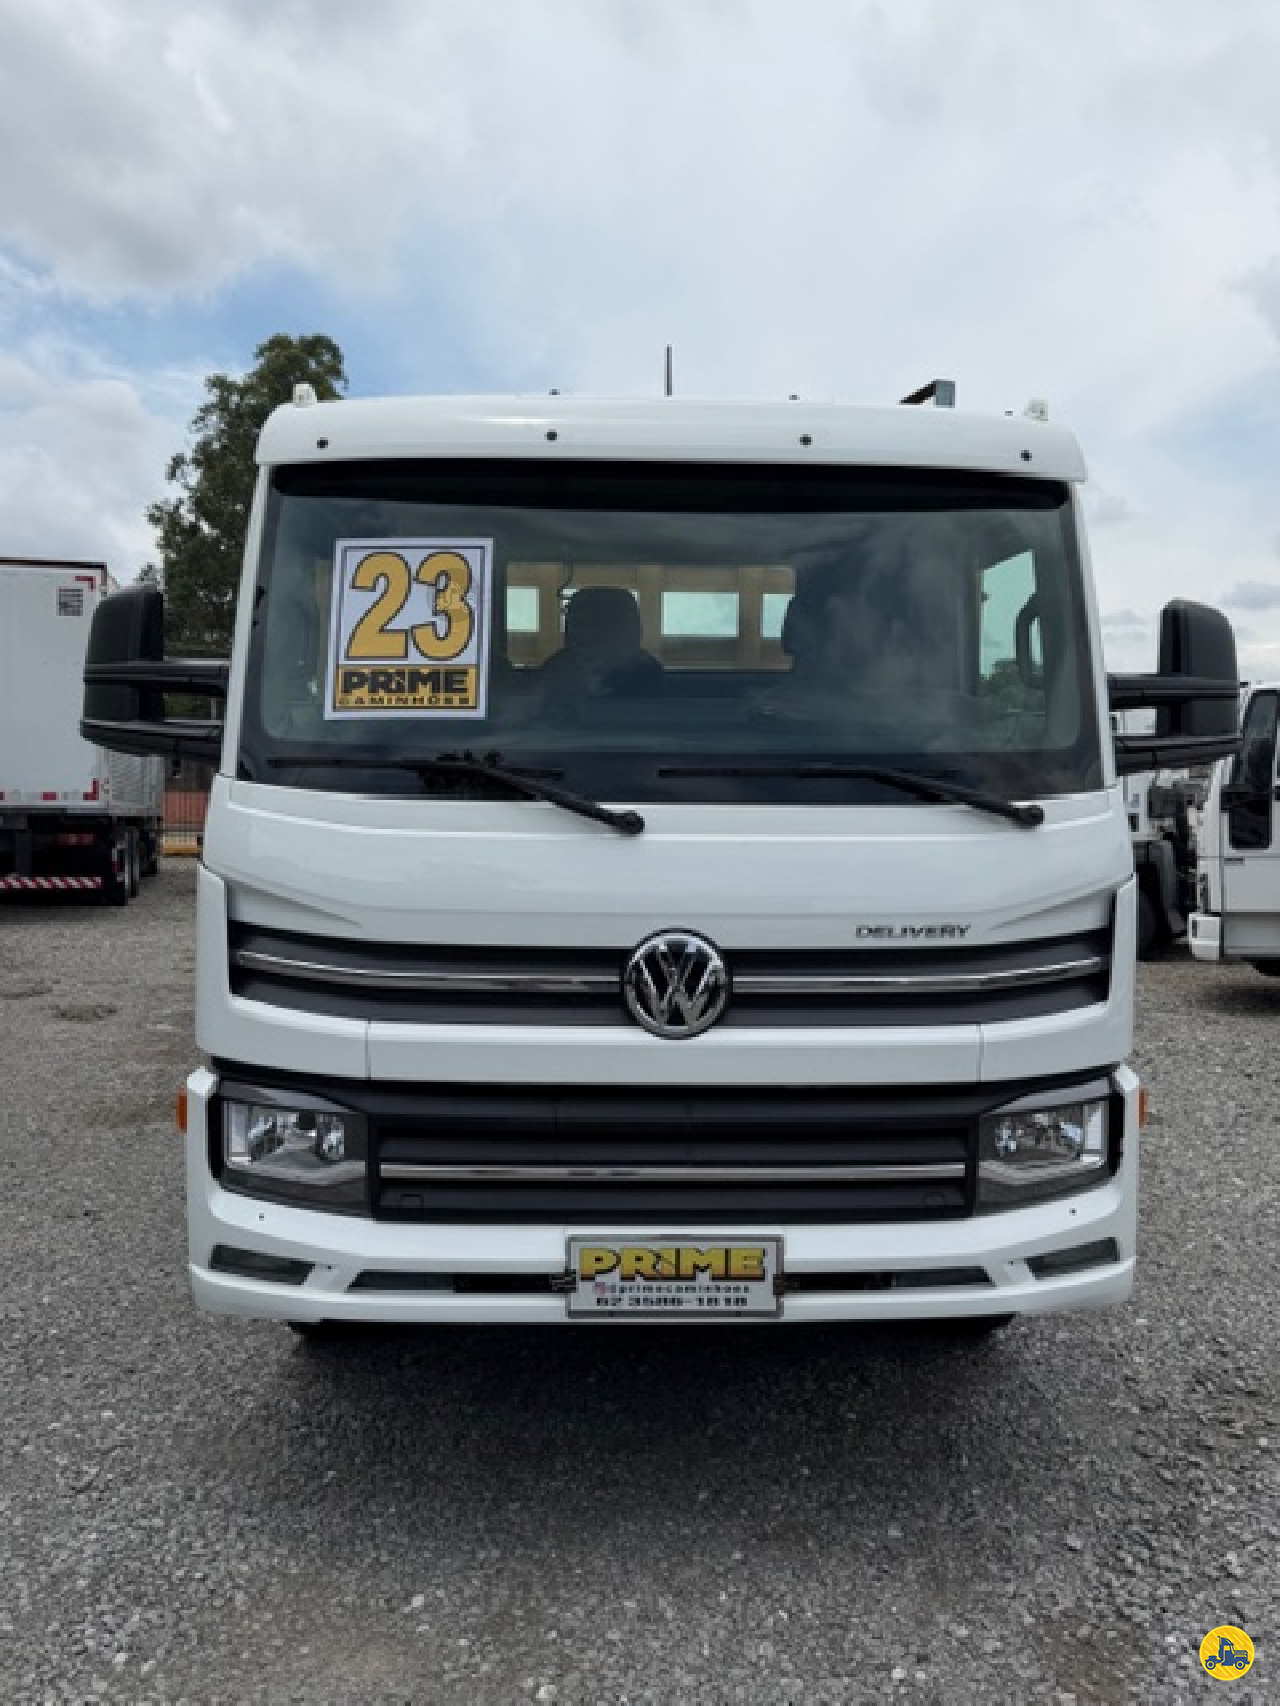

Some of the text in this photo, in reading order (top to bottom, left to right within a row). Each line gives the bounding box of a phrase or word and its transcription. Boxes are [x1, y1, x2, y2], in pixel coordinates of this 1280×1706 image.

[345, 551, 474, 661] 23
[342, 668, 470, 694] PRIME
[855, 923, 971, 939] DELIVERY
[579, 1247, 766, 1282] PRIME
